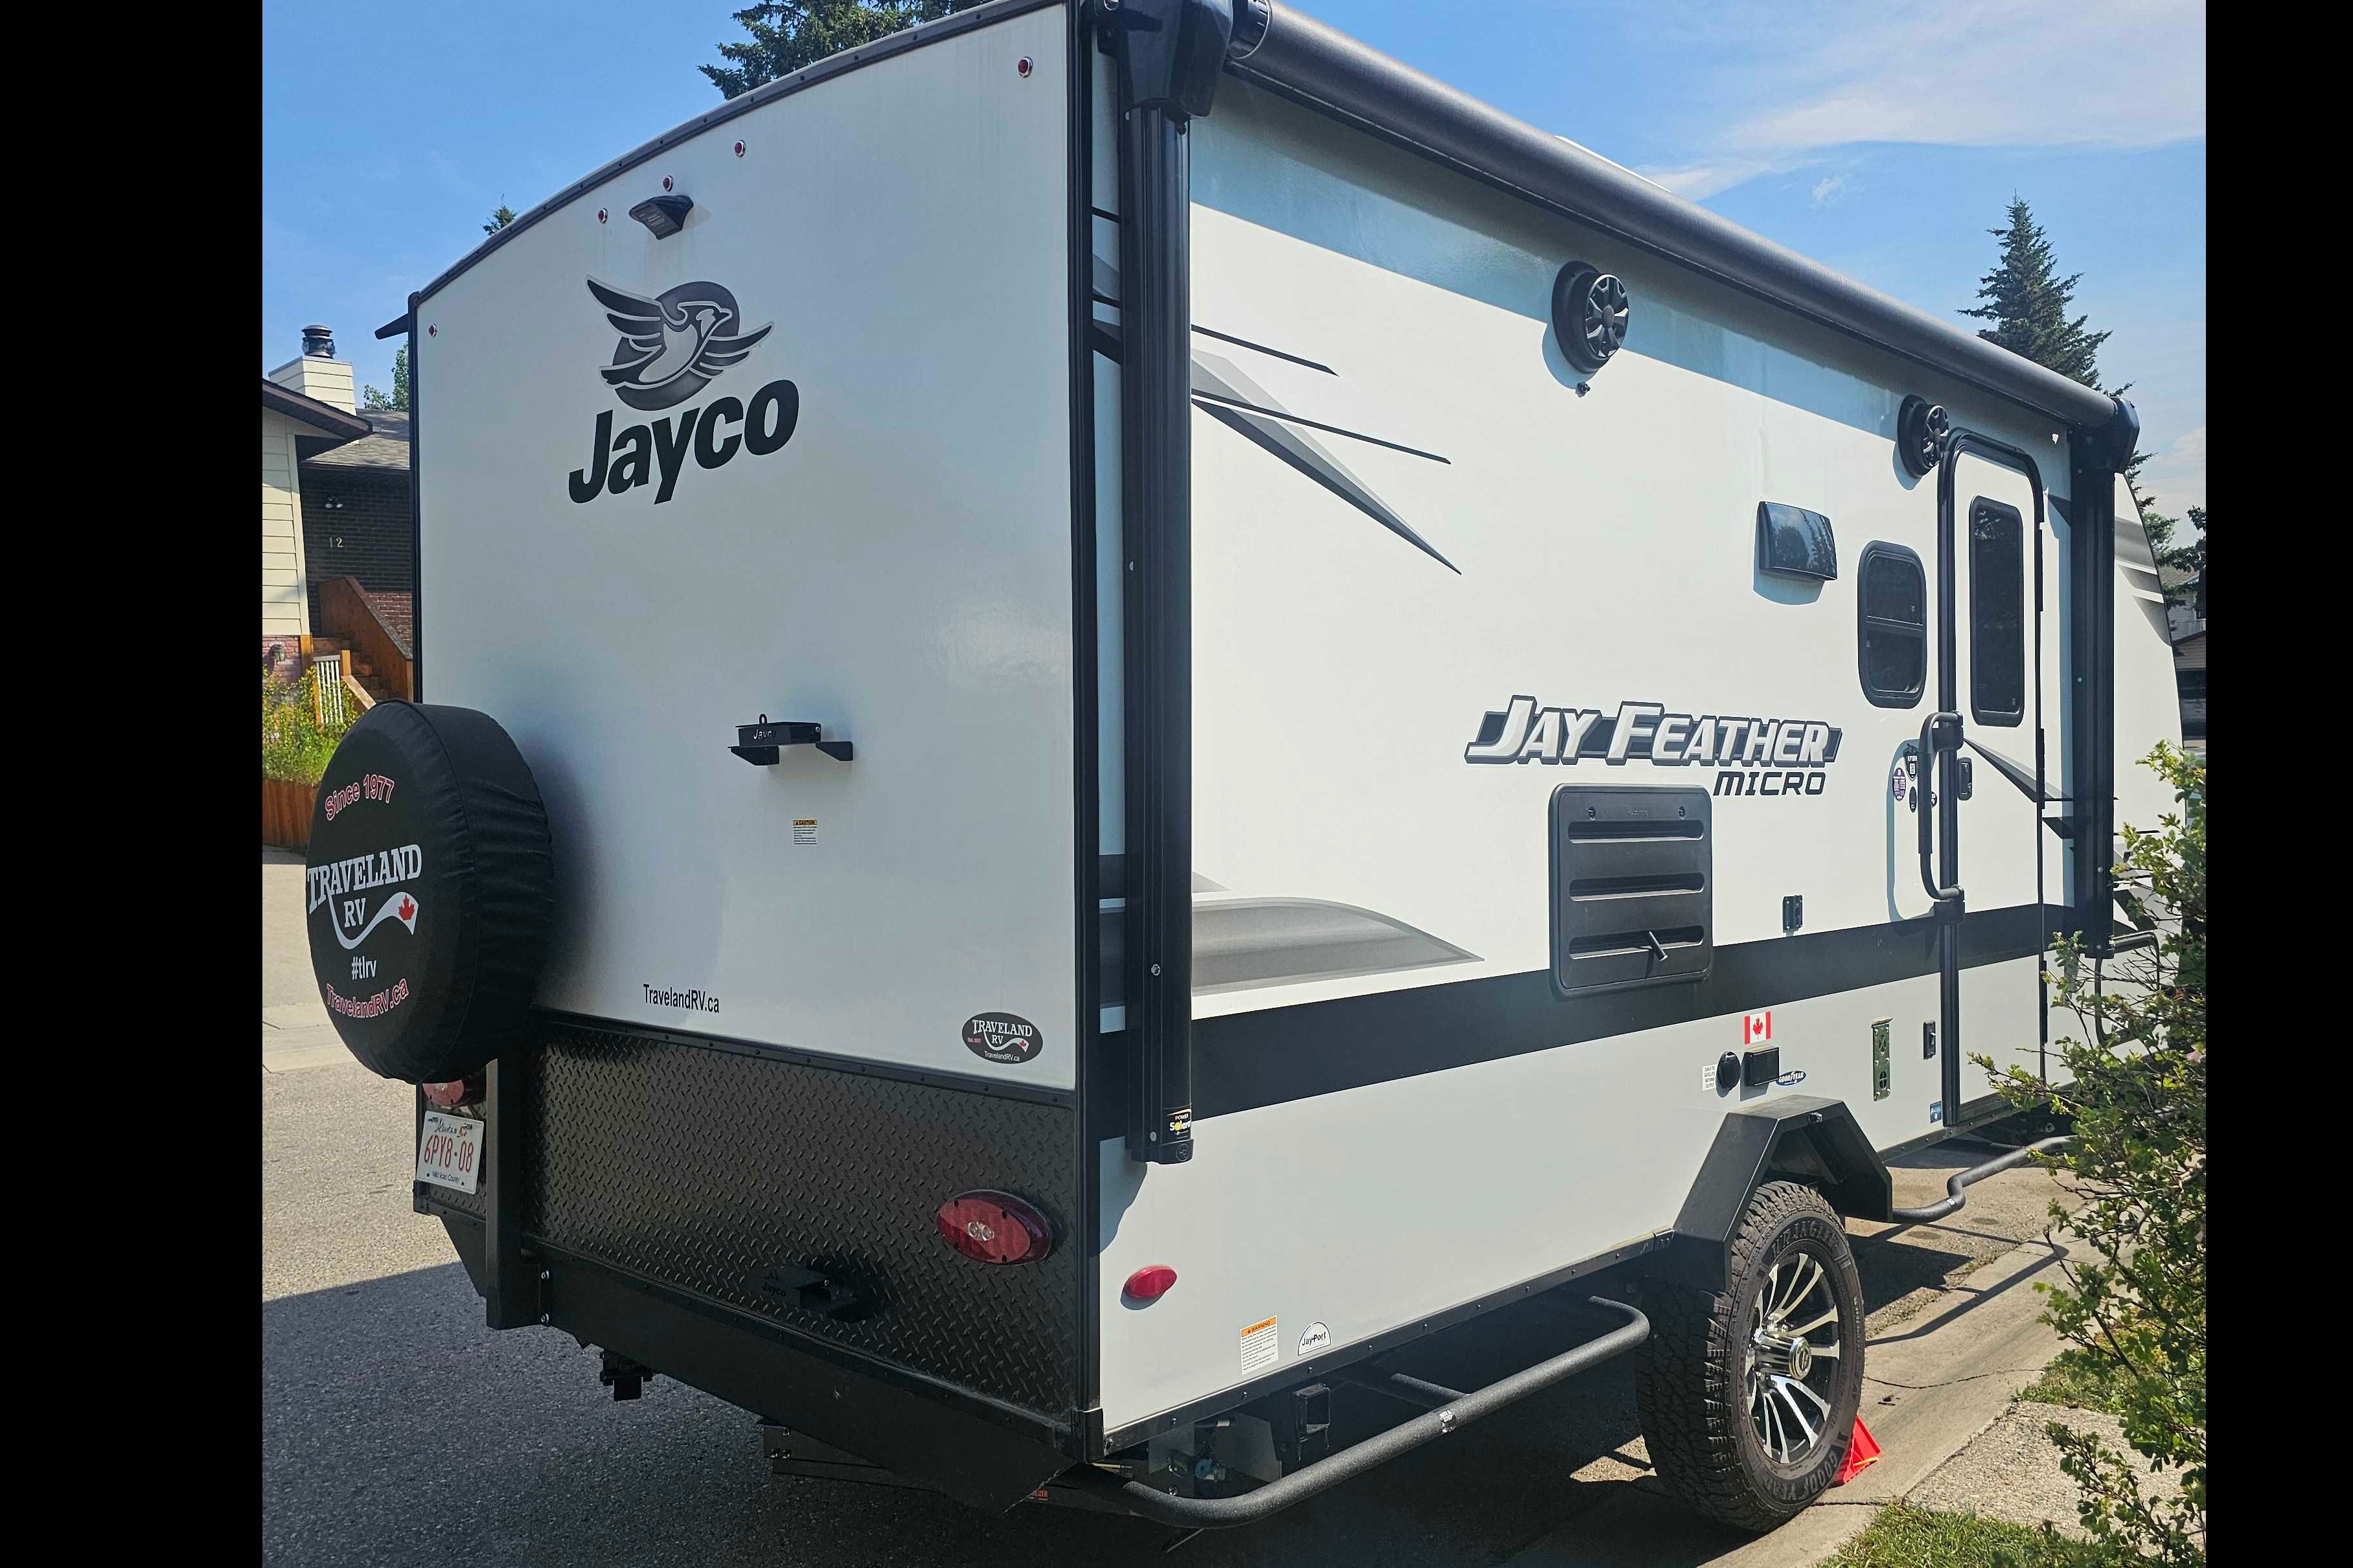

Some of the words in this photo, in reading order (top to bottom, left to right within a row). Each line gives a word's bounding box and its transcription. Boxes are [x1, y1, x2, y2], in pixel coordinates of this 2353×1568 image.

[569, 380, 799, 505] Jayco
[1464, 695, 1601, 765] JAY
[1606, 701, 1828, 767] FEATHER
[325, 782, 360, 821] Since
[363, 773, 395, 804] 1977
[1713, 771, 1826, 796] MICRO
[307, 844, 422, 915] TRAVELAND
[343, 898, 367, 927] RV
[351, 955, 377, 981] #tlrv
[327, 978, 409, 1018] TravelandRV.ca
[643, 983, 720, 1014] TravelandRV.ca
[972, 1019, 1033, 1037] TRAVELAND
[991, 1034, 1004, 1045] RV
[984, 1051, 1020, 1062] TravelandRV.ca
